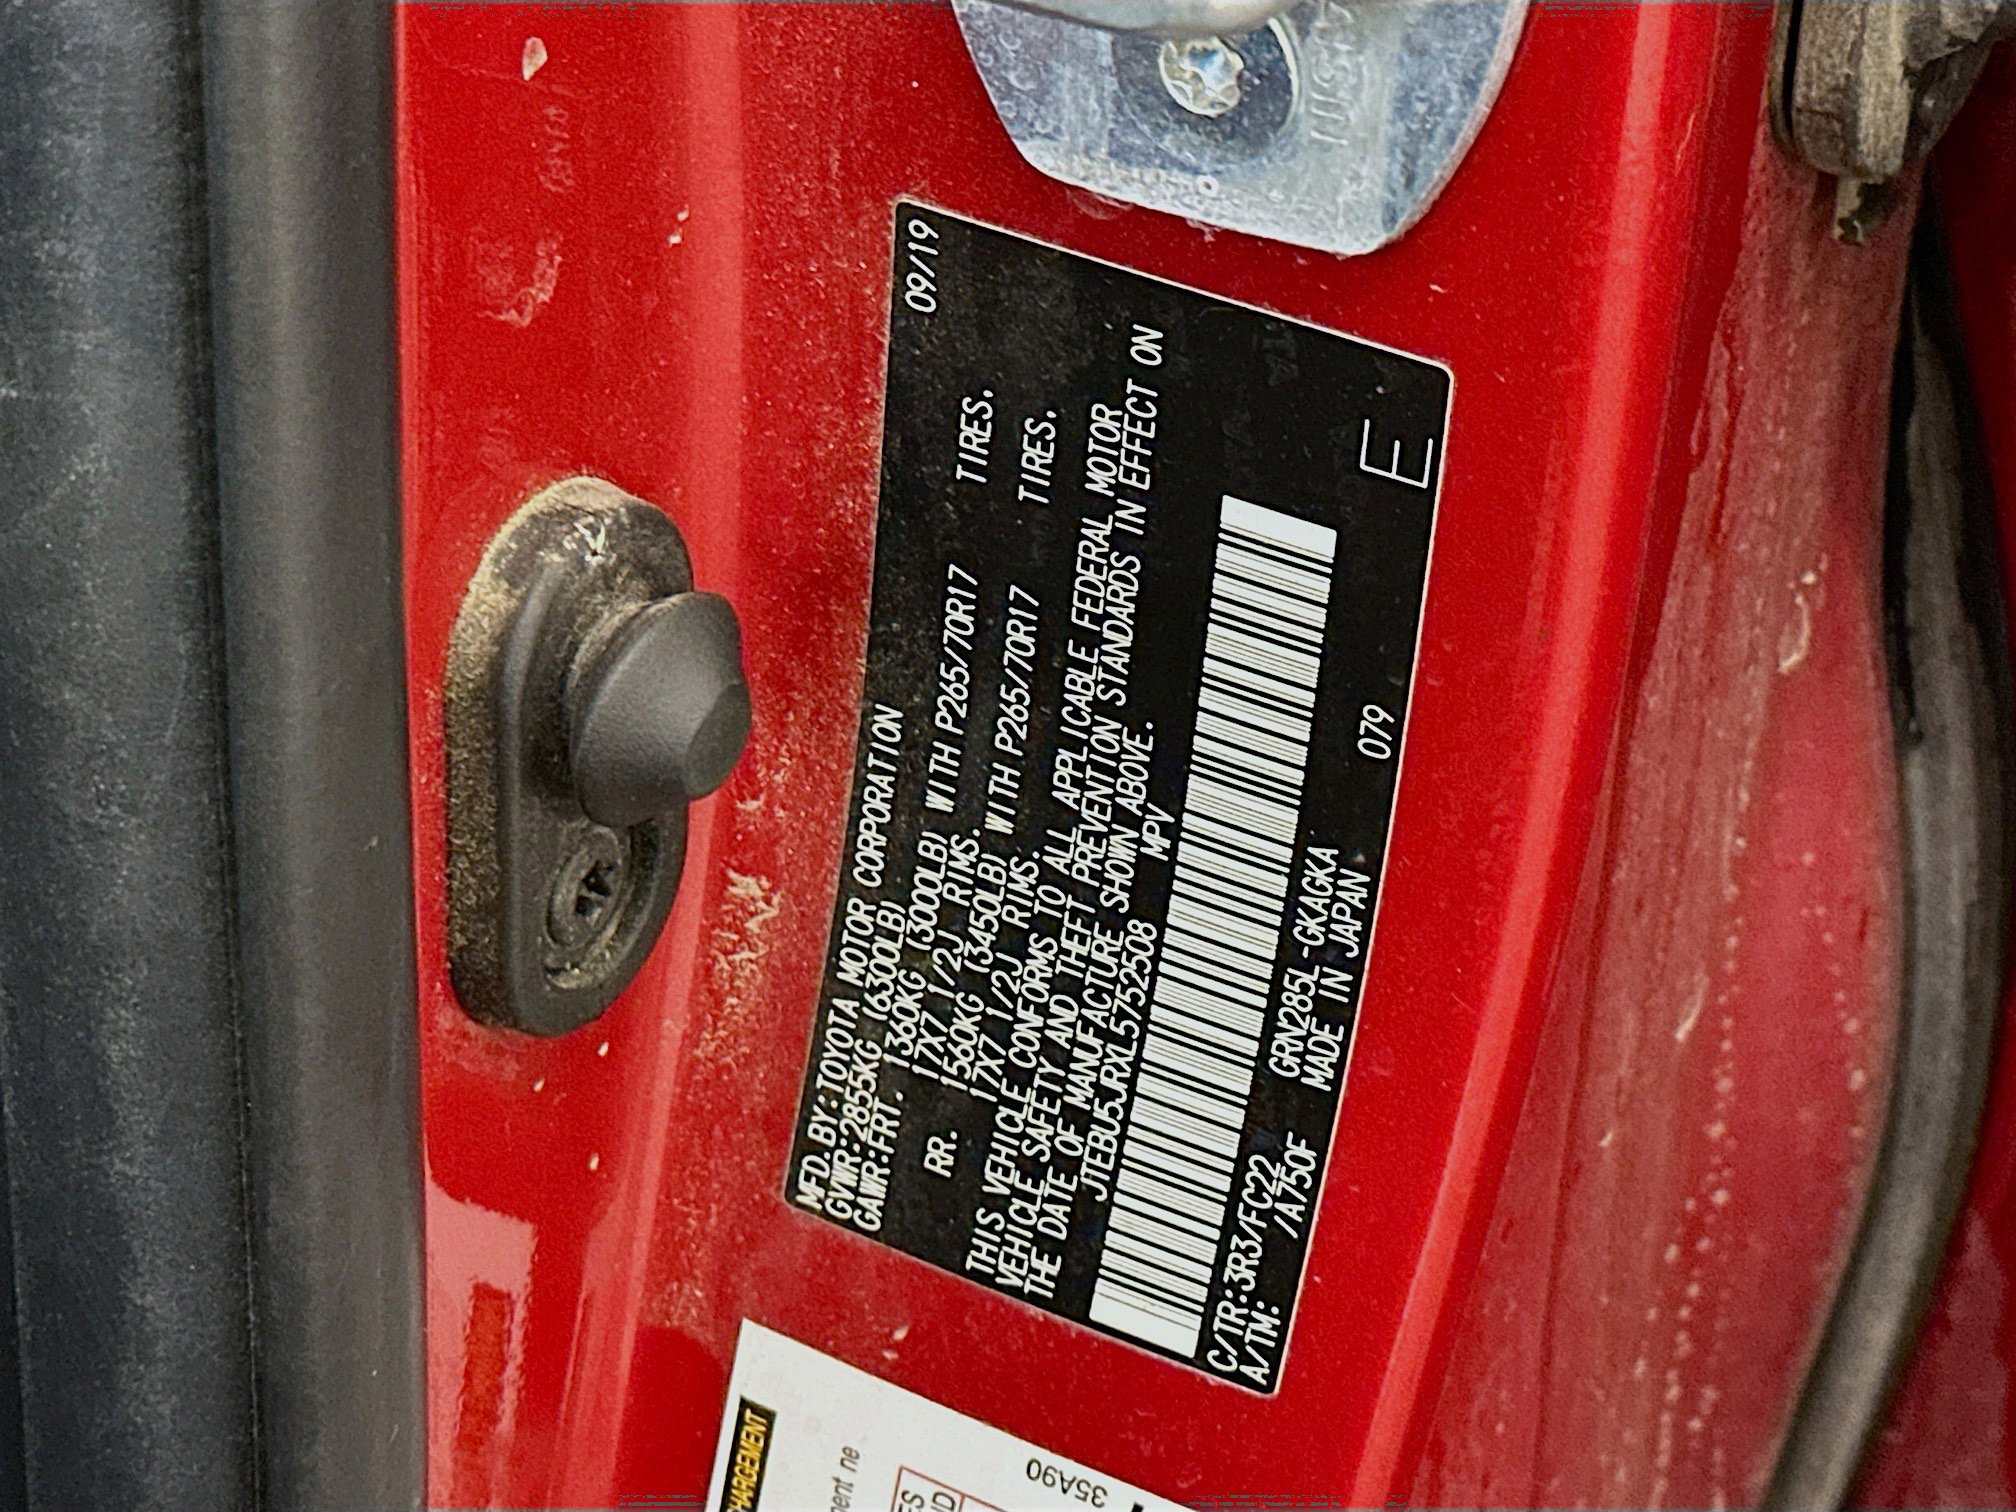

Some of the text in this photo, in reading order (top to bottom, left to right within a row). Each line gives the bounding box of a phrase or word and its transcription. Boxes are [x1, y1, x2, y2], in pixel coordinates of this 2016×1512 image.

[905, 219, 939, 312] 09/19
[956, 390, 993, 482] TIRES.
[1360, 419, 1433, 488] E
[935, 564, 978, 735] P265/70R17
[853, 704, 903, 887] CORPORATION
[925, 741, 961, 812] WITH
[941, 411, 1056, 1090] 1560KG (3450LB) WITH P265/70R17 TIRES.
[996, 324, 1163, 1292] VEHICLE SAFETY AND THEFT PREVENTION STANDARDS IN EFFECT ON
[906, 831, 951, 950] (3000LB)
[966, 404, 1123, 1274] THIS VEHICLE CONFORMS TO ALL APPLICABLE FEDERAL MOTOR
[837, 898, 876, 986] MOTOR
[862, 901, 906, 1020] (6300LB)
[913, 829, 980, 1080] 17X7 1/2J RIMS.
[971, 848, 1040, 1102] 17X7 1/2J RIMS.
[883, 969, 926, 1067] 1360KG
[1027, 722, 1153, 1298] THE DATE OF MANUFACTURE SHOWN ABOVE.
[1080, 803, 1175, 1201] JTEBU5JRXL5752508 MPV
[1240, 705, 1394, 1385] A/TM: /A750F MADE IN JAPAN 079
[924, 1131, 957, 1177] RR.
[840, 1446, 860, 1472] ne
[1026, 1458, 1108, 1508] 35A90
